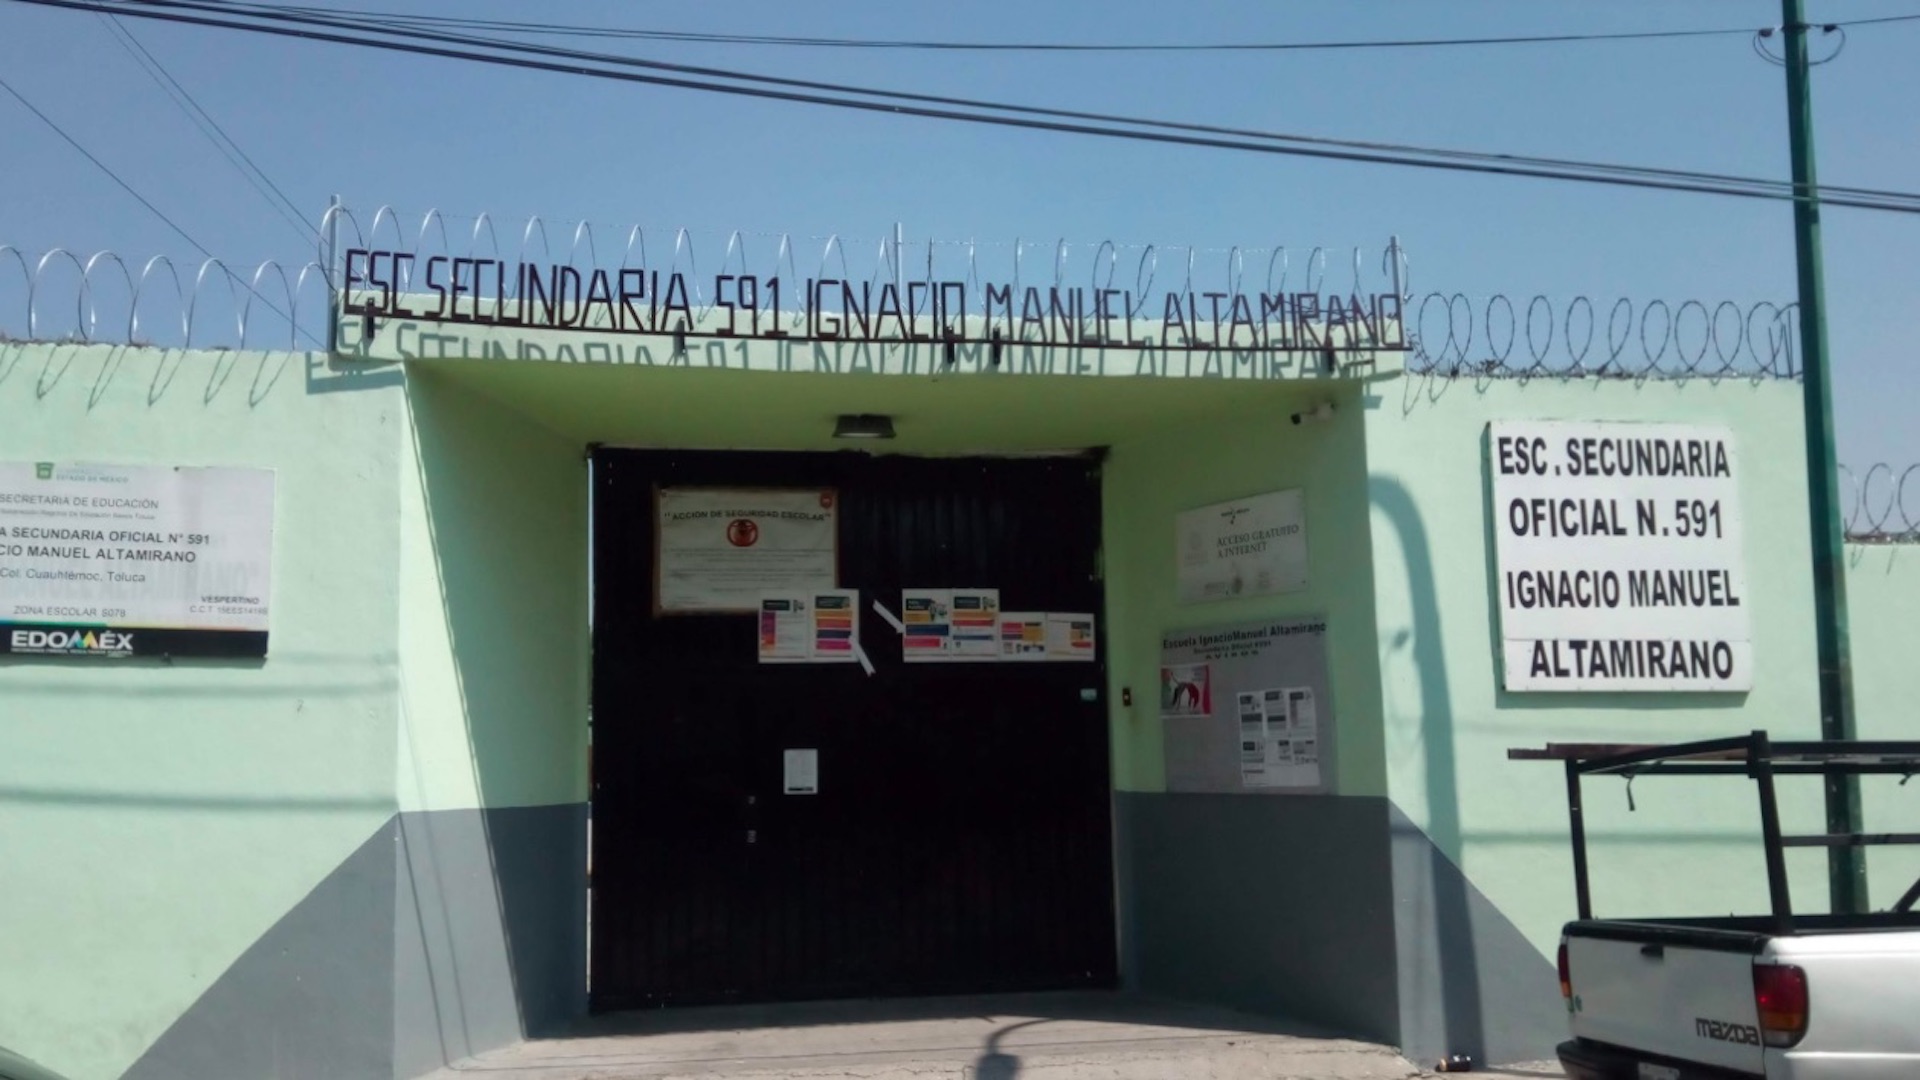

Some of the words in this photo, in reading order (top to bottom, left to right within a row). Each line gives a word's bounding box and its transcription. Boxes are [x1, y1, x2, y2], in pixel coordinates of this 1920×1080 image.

[424, 256, 694, 334] SECUNDARIA
[716, 275, 788, 337] 591
[807, 278, 965, 343] IGNACIO
[986, 282, 1147, 346] MANUEL
[1162, 292, 1403, 350] ALTAMIRANO
[1566, 438, 1731, 477] SECUNDARIA
[73, 496, 89, 506] DE
[710, 510, 722, 518] DE
[725, 509, 779, 519] SEGURIDAD
[1509, 498, 1627, 538] OFICIAL
[12, 527, 104, 541] SECUNDARIA
[109, 531, 163, 544] OFICIAL
[187, 534, 210, 545] 591
[1217, 533, 1250, 548] ACCESO
[1251, 524, 1300, 541] GRATUITO
[27, 545, 91, 559] MANUEL
[96, 548, 197, 563] ALTAMIRANO
[1225, 542, 1267, 557] INTERNET
[107, 571, 146, 583] Toluca
[1507, 570, 1620, 609] IGNACIO
[1628, 570, 1741, 608] MANUEL
[201, 595, 260, 605] VESPERTINO
[14, 605, 44, 615] ZONA
[47, 606, 97, 617] ESCOLAR
[1163, 636, 1197, 649] Escuela
[1530, 639, 1734, 680] ALTAMIRANO
